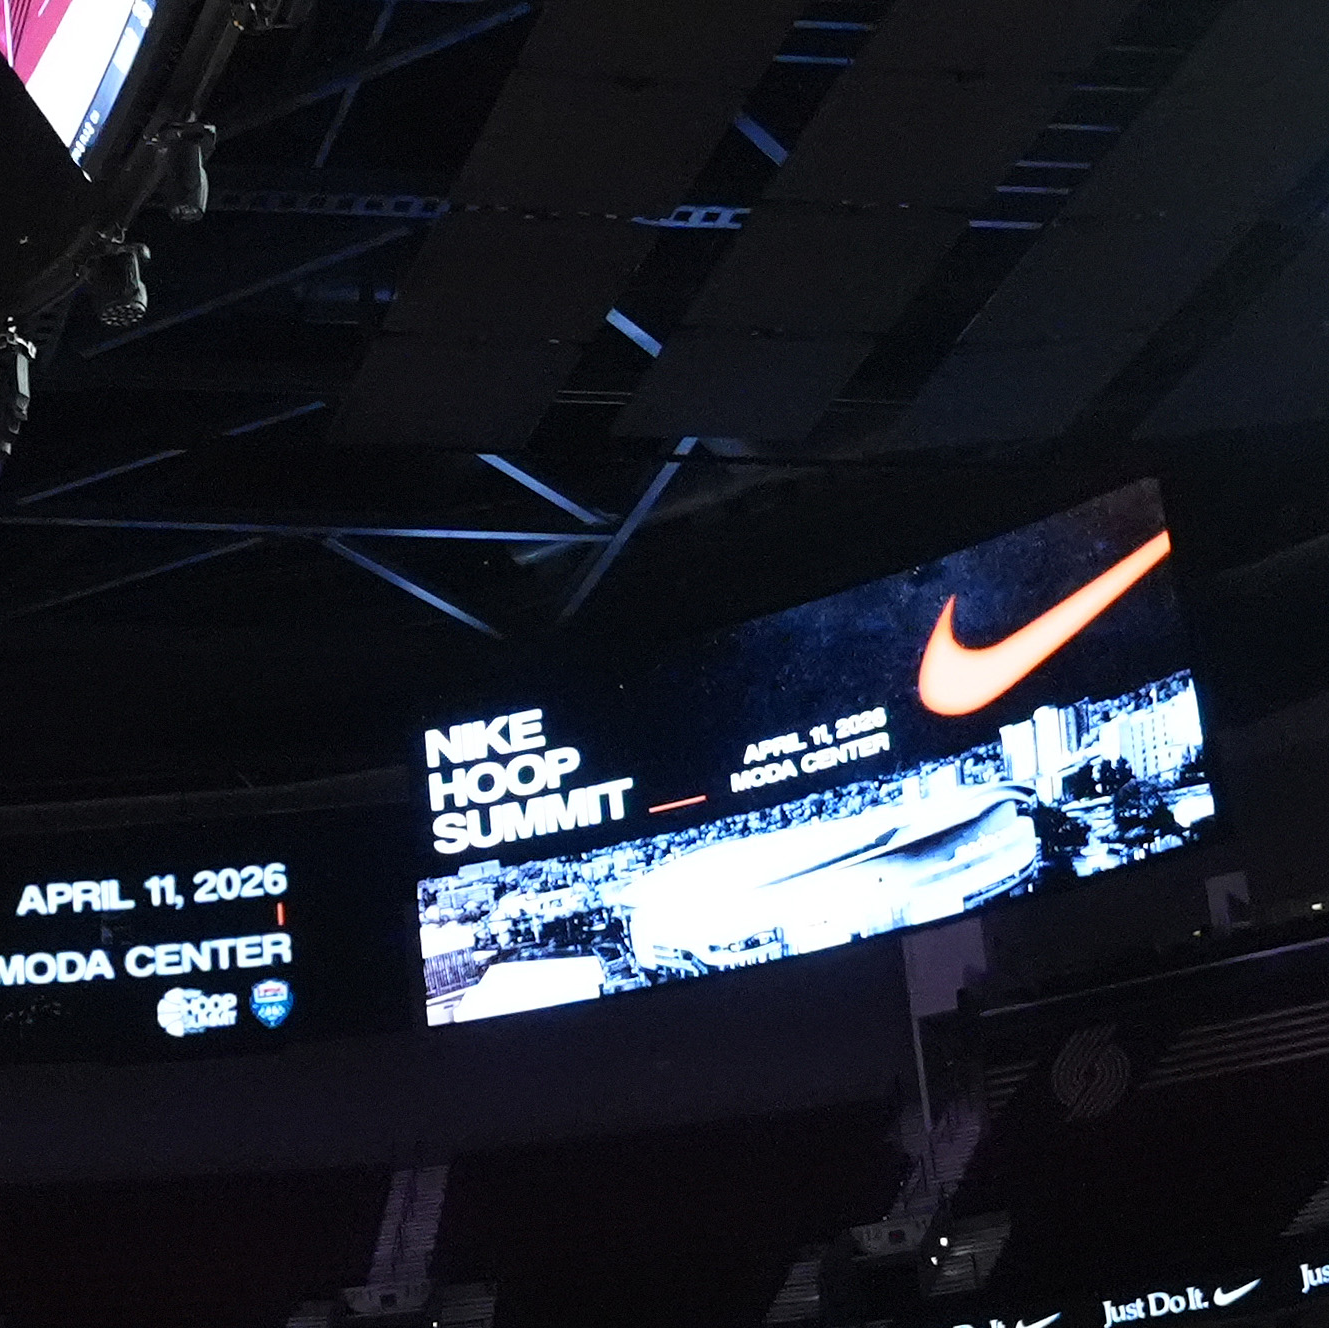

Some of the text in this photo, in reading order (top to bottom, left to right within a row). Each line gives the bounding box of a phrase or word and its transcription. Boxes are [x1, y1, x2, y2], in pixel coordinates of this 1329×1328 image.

[425, 708, 547, 769] NIKE
[729, 731, 891, 793] MODA CENTER
[743, 731, 809, 765] APRIL
[834, 706, 888, 740] 2026
[429, 746, 581, 812] HOOP
[433, 777, 634, 855] SUMMIT
[17, 862, 288, 916] APRIL 11, 2026
[125, 932, 292, 978] CENTER
[1102, 1286, 1209, 1328] Just Do It.
[1299, 1263, 1329, 1294] Jus
